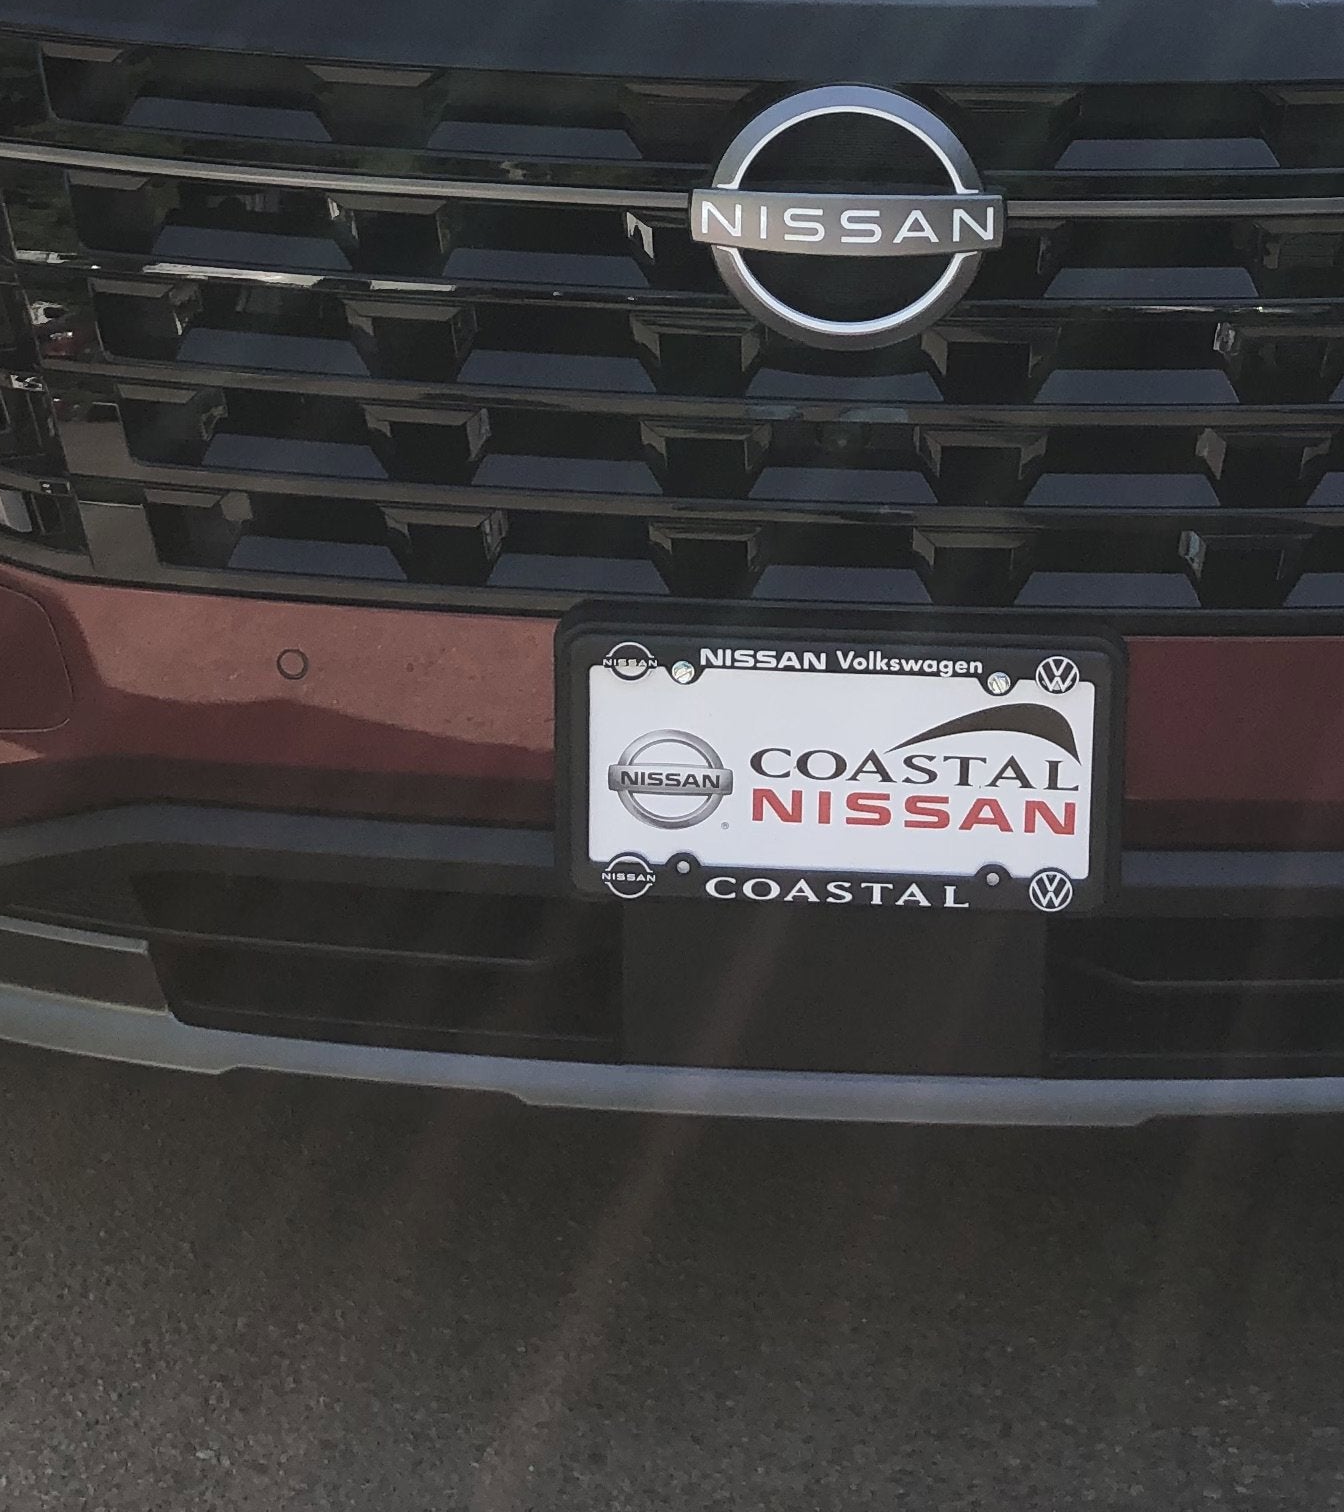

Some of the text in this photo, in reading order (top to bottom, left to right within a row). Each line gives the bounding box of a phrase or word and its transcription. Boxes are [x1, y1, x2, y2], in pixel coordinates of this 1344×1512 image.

[701, 199, 995, 244] NISSAN
[602, 658, 657, 668] NISSAN
[699, 648, 983, 678] NISSAN Volkswagen
[620, 769, 721, 790] NISSAN
[749, 747, 1080, 792] COASTAL
[751, 787, 1076, 836] NISSAN
[601, 871, 656, 883] NISSAN
[705, 876, 970, 908] COASTAL
